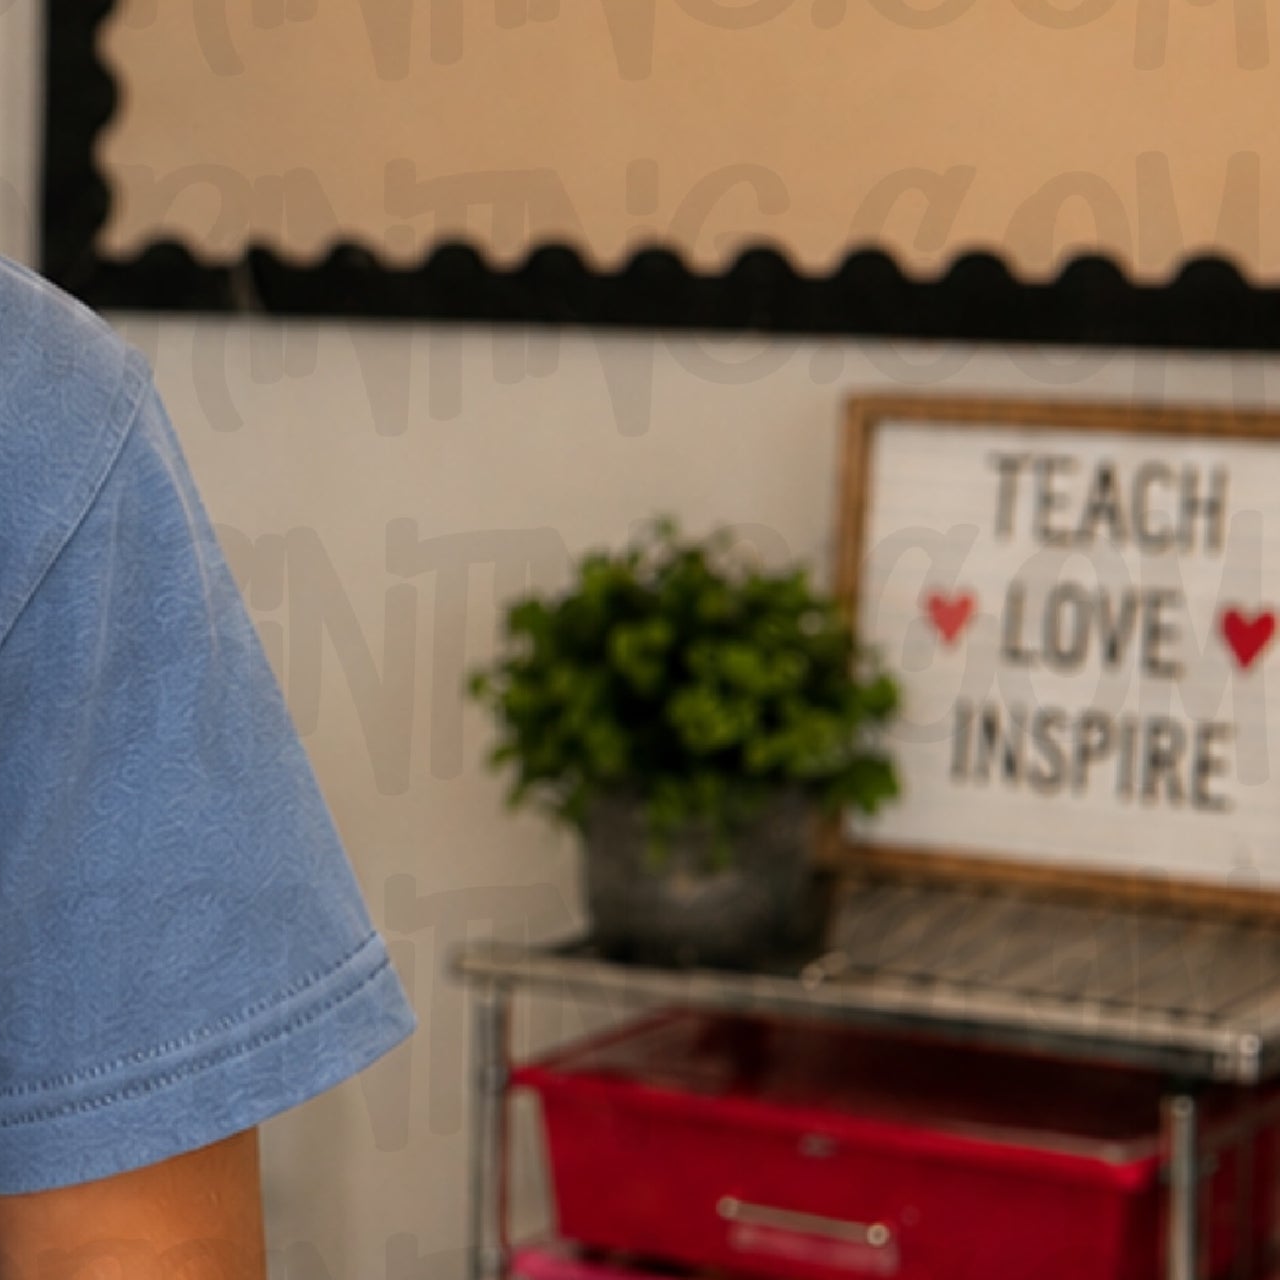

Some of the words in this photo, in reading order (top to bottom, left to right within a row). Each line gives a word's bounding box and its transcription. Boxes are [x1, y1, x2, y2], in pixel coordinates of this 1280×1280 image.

[989, 451, 1230, 555] TEACH
[1000, 581, 1187, 680] LOVE
[949, 699, 1237, 812] INSPIRE
